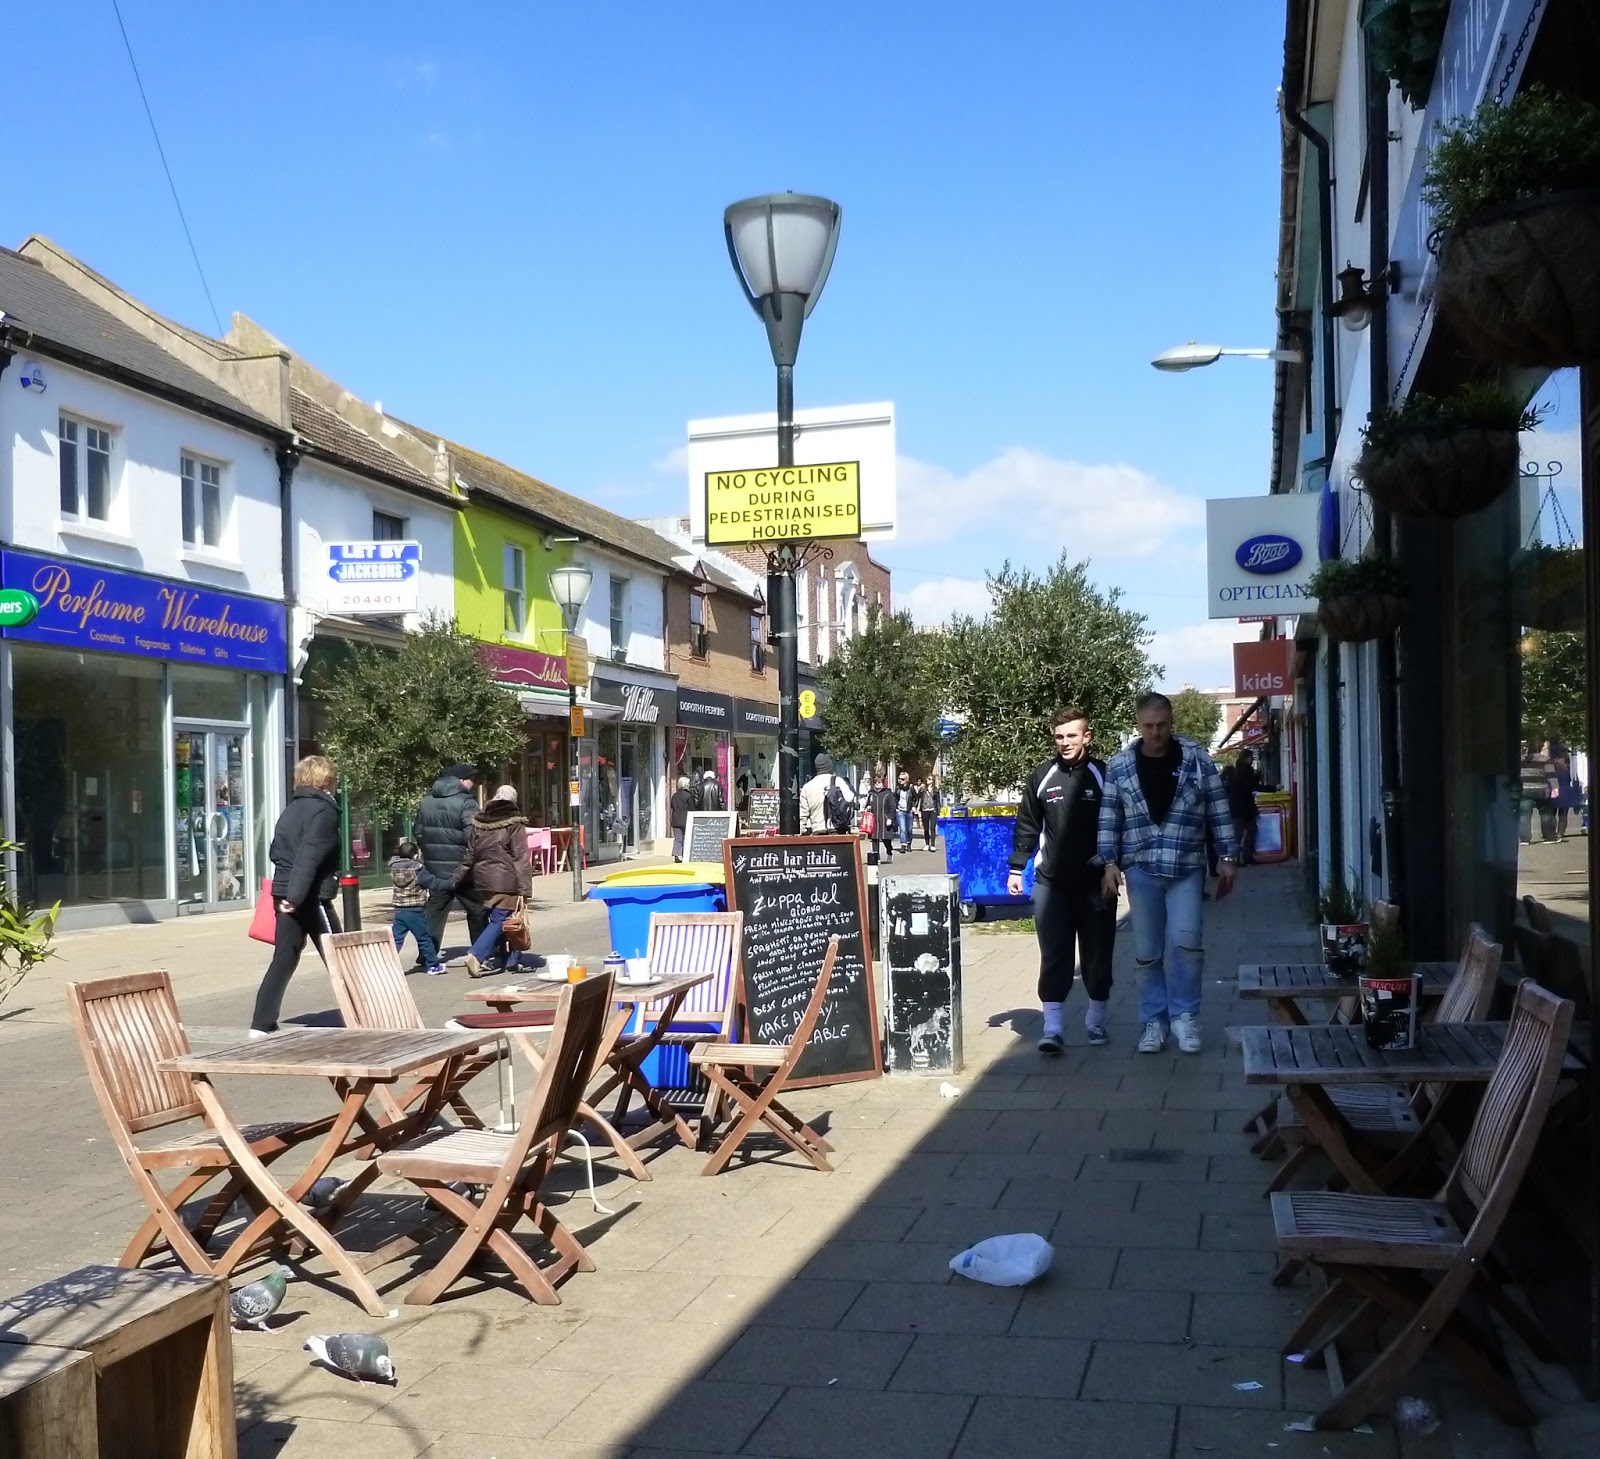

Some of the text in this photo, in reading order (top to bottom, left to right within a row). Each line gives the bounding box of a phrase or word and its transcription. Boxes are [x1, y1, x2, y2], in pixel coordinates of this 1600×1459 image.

[717, 466, 847, 490] NO CYCLING
[749, 489, 815, 506] DURING
[710, 503, 856, 525] PEDESTRIANISED
[753, 523, 812, 538] HOURS
[342, 545, 405, 559] LET BY
[1244, 542, 1290, 567] Boots
[339, 563, 403, 579] JACKSONS
[343, 595, 401, 605] 204401
[1219, 584, 1309, 601] OPTICIAN
[32, 565, 269, 644] Perfume Warehouse
[89, 629, 229, 659] Cosmetics Fragrances Toiletries Gifts
[1242, 673, 1284, 691] kids
[680, 701, 726, 717] DOROTHY PERKINS
[745, 712, 780, 725] DOROTHY PERKIN
[750, 849, 837, 868] caffè bar italia
[810, 882, 841, 905] del
[744, 922, 768, 935] FRESH
[816, 912, 836, 922] PASTA
[747, 934, 790, 959] SPAGHETTI
[752, 970, 774, 984] FRESH
[776, 963, 793, 974] MADE
[753, 999, 776, 1016] BEST
[758, 1013, 789, 1039] TAKE
